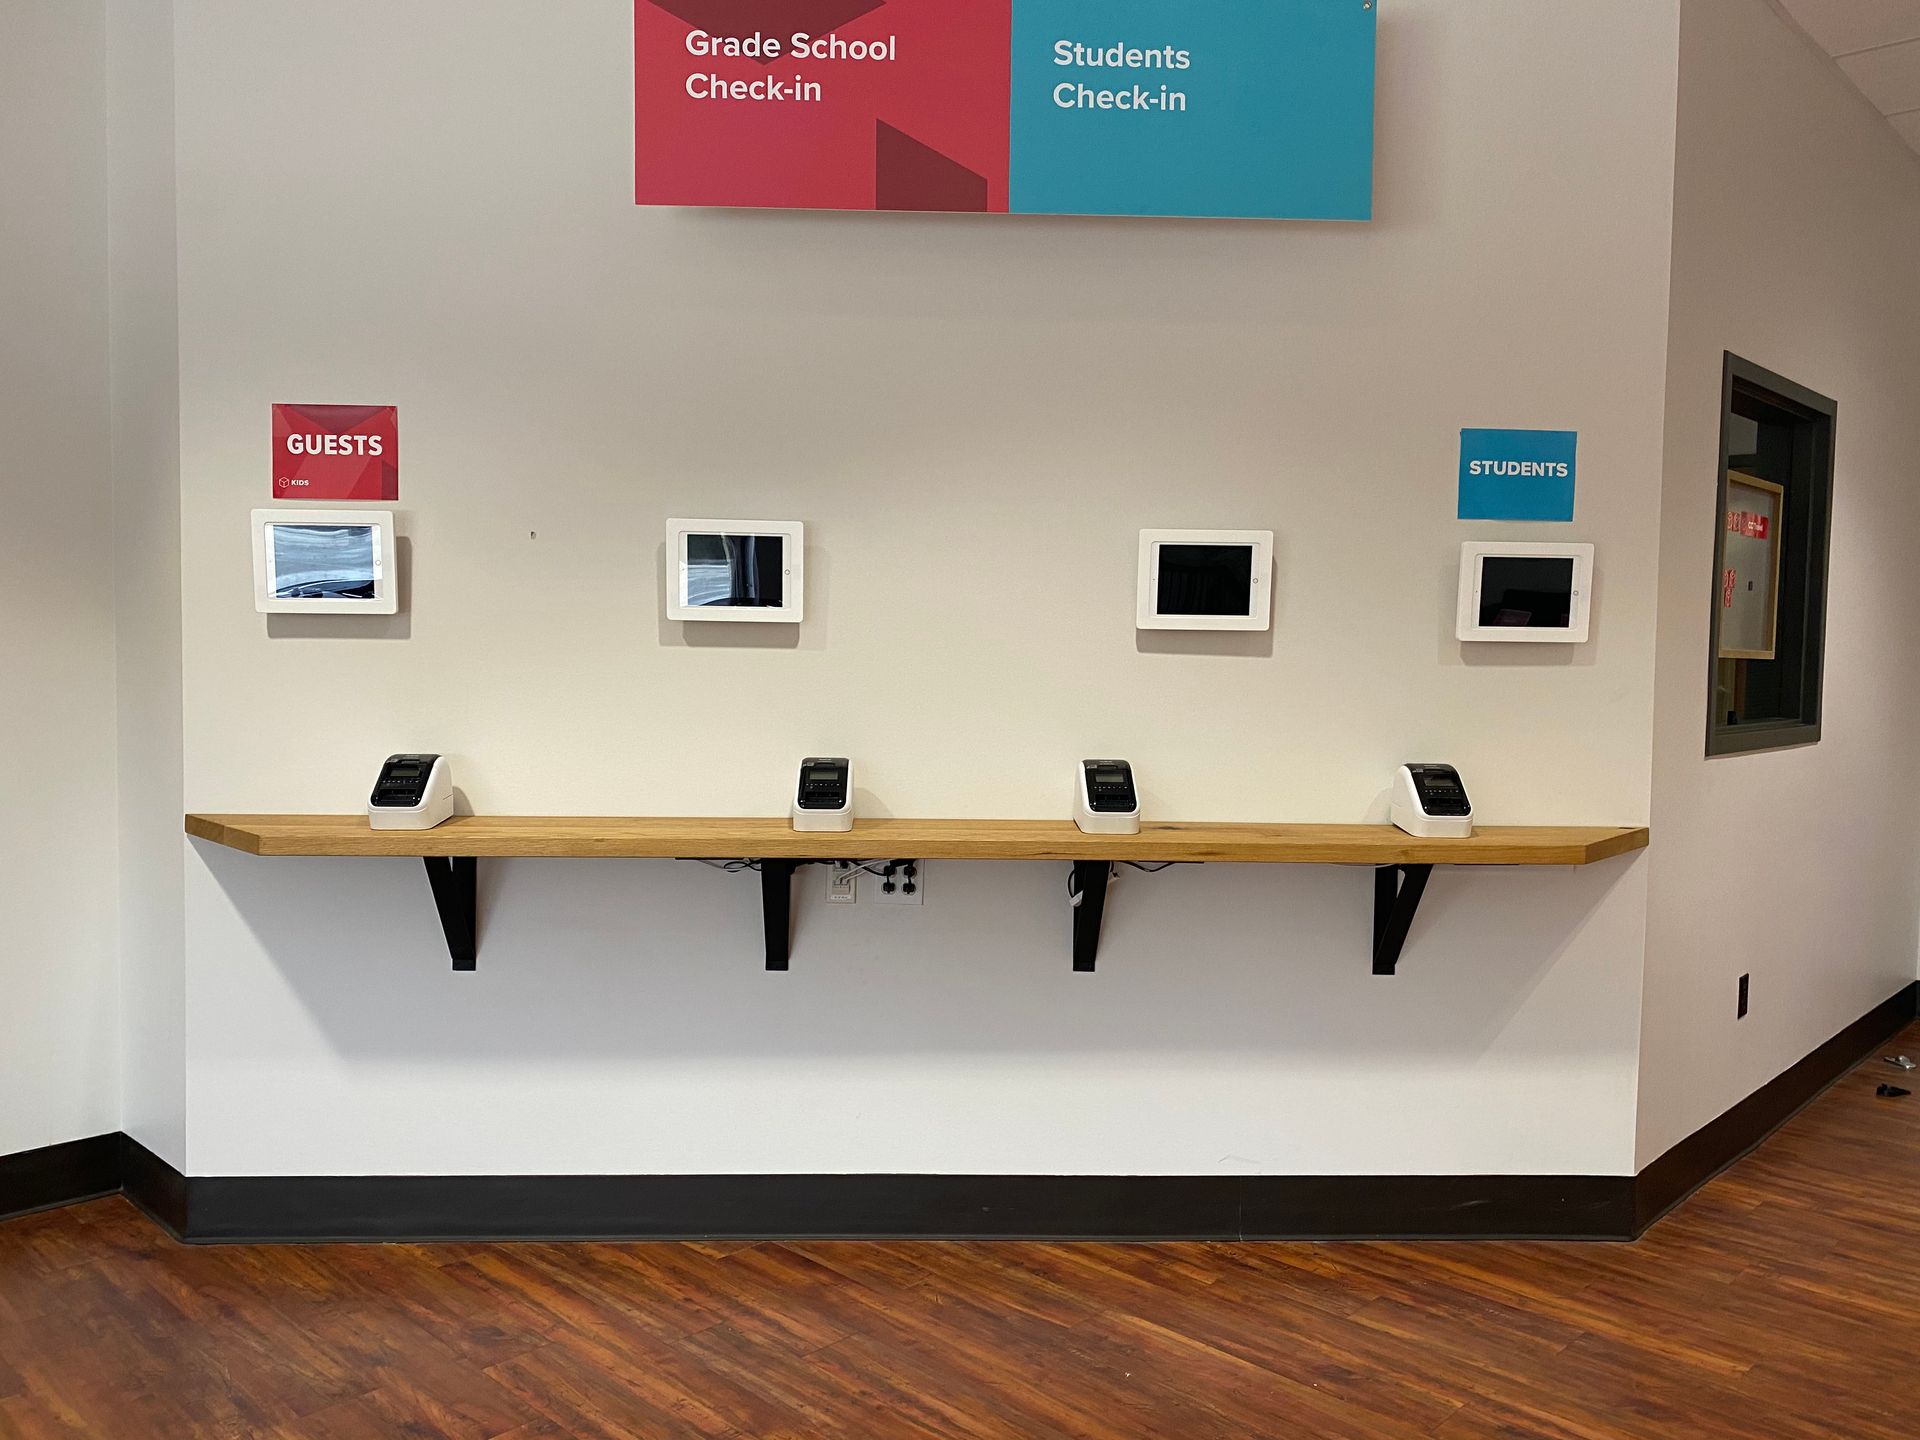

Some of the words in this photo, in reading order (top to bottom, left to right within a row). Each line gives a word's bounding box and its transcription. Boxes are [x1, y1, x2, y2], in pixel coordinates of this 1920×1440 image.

[685, 29, 781, 59] Grade
[789, 32, 897, 62] School
[1053, 40, 1191, 70] Students
[684, 73, 822, 103] Check-in
[1053, 82, 1188, 112] Check-in
[286, 433, 383, 456] GUESTS
[1469, 460, 1569, 477] STUDENTS
